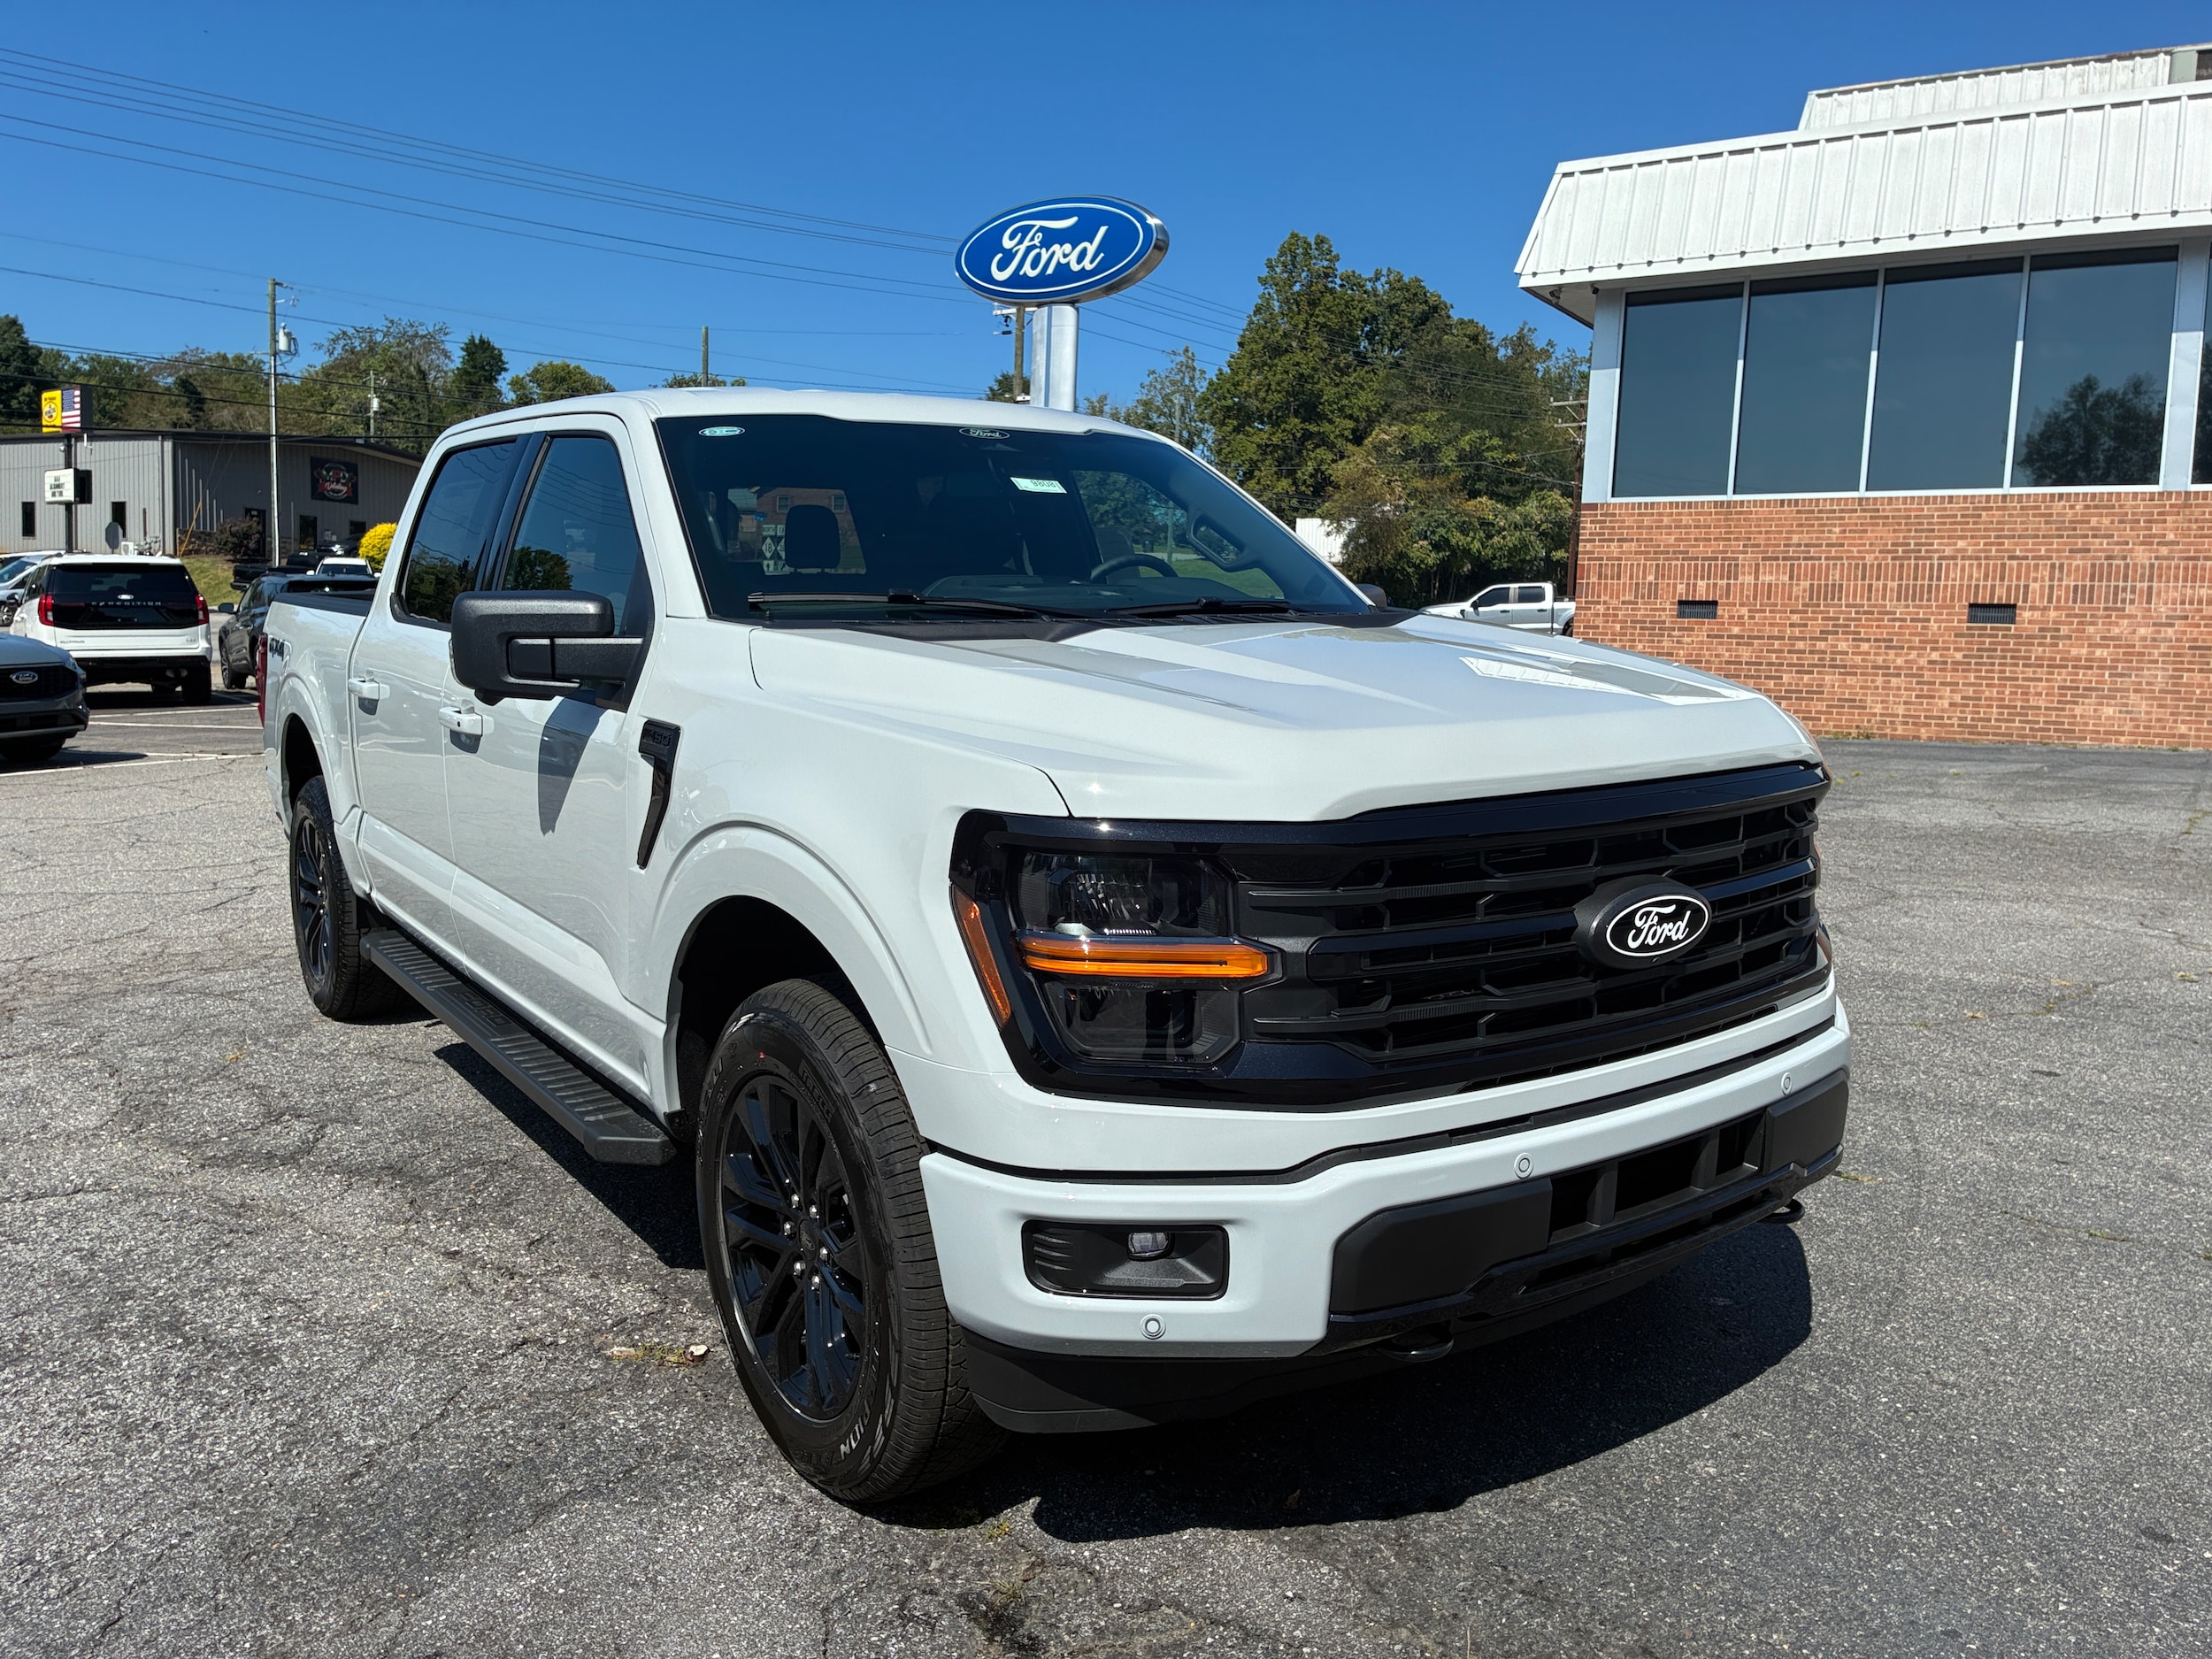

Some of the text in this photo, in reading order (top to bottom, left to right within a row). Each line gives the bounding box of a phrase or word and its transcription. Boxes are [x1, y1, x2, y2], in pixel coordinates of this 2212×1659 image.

[990, 216, 1110, 281] Ford
[969, 428, 1002, 437] Ford
[1627, 904, 1692, 949] Ford
[454, 990, 513, 1026] FORD
